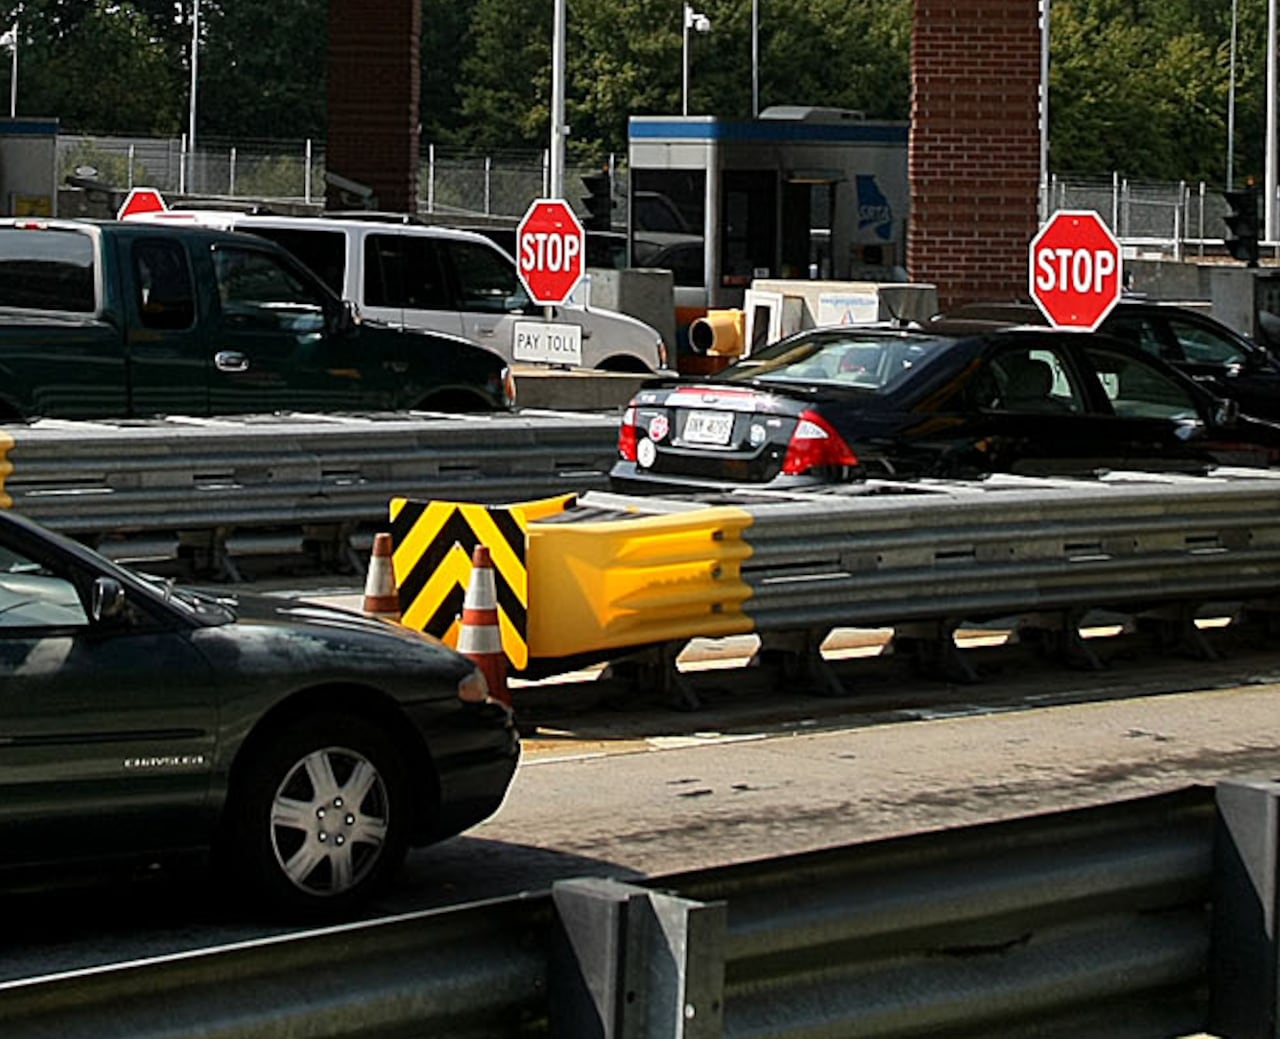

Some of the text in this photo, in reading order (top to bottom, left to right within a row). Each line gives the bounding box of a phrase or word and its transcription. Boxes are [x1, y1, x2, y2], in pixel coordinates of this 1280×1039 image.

[521, 232, 580, 272] STOP
[1036, 247, 1115, 293] STOP
[518, 334, 577, 352] PAY TOLL
